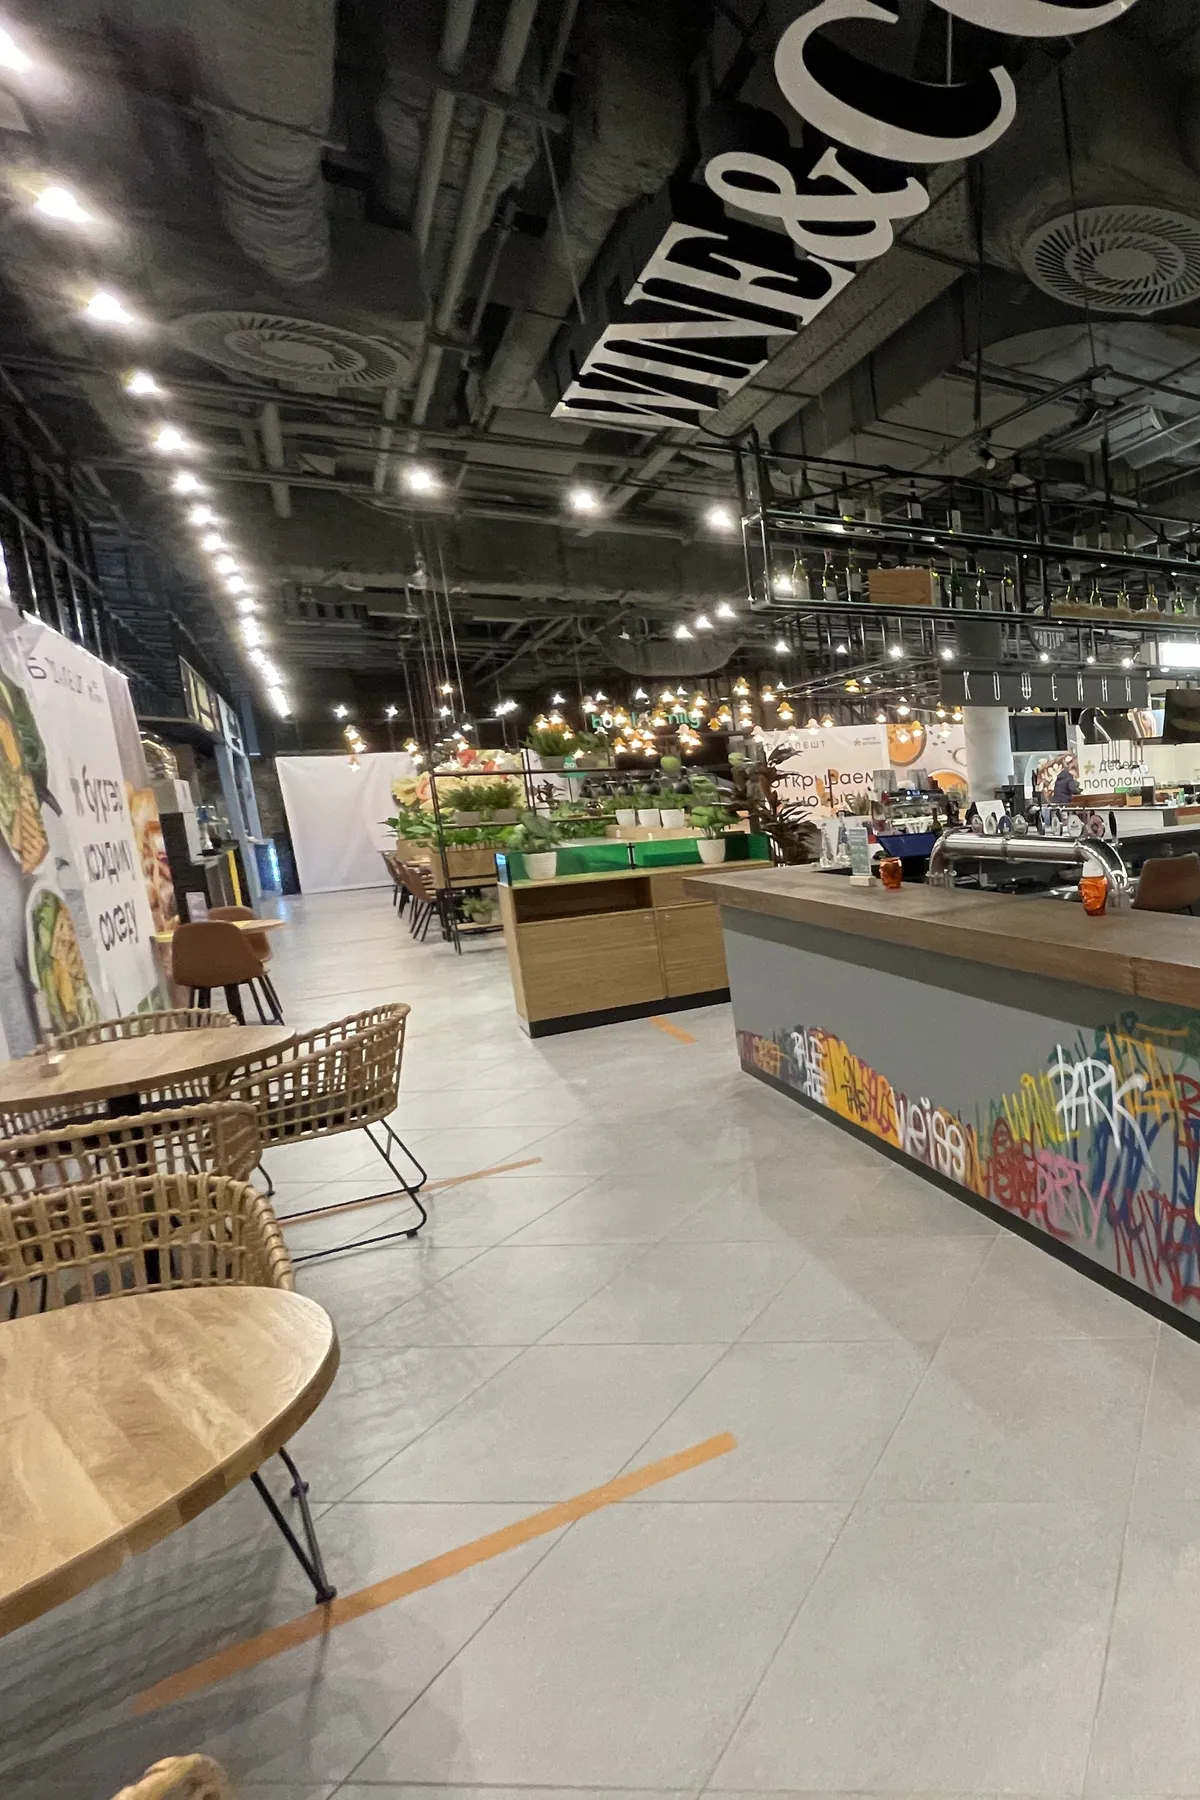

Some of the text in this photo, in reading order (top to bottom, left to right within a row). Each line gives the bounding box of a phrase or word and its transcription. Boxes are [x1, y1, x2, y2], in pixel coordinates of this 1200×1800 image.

[550, 0, 1138, 429] WINE&C
[962, 670, 1132, 702] КОФЕЙНЯ
[765, 740, 825, 751] БАПЕШТ
[1084, 776, 1142, 789] пополам
